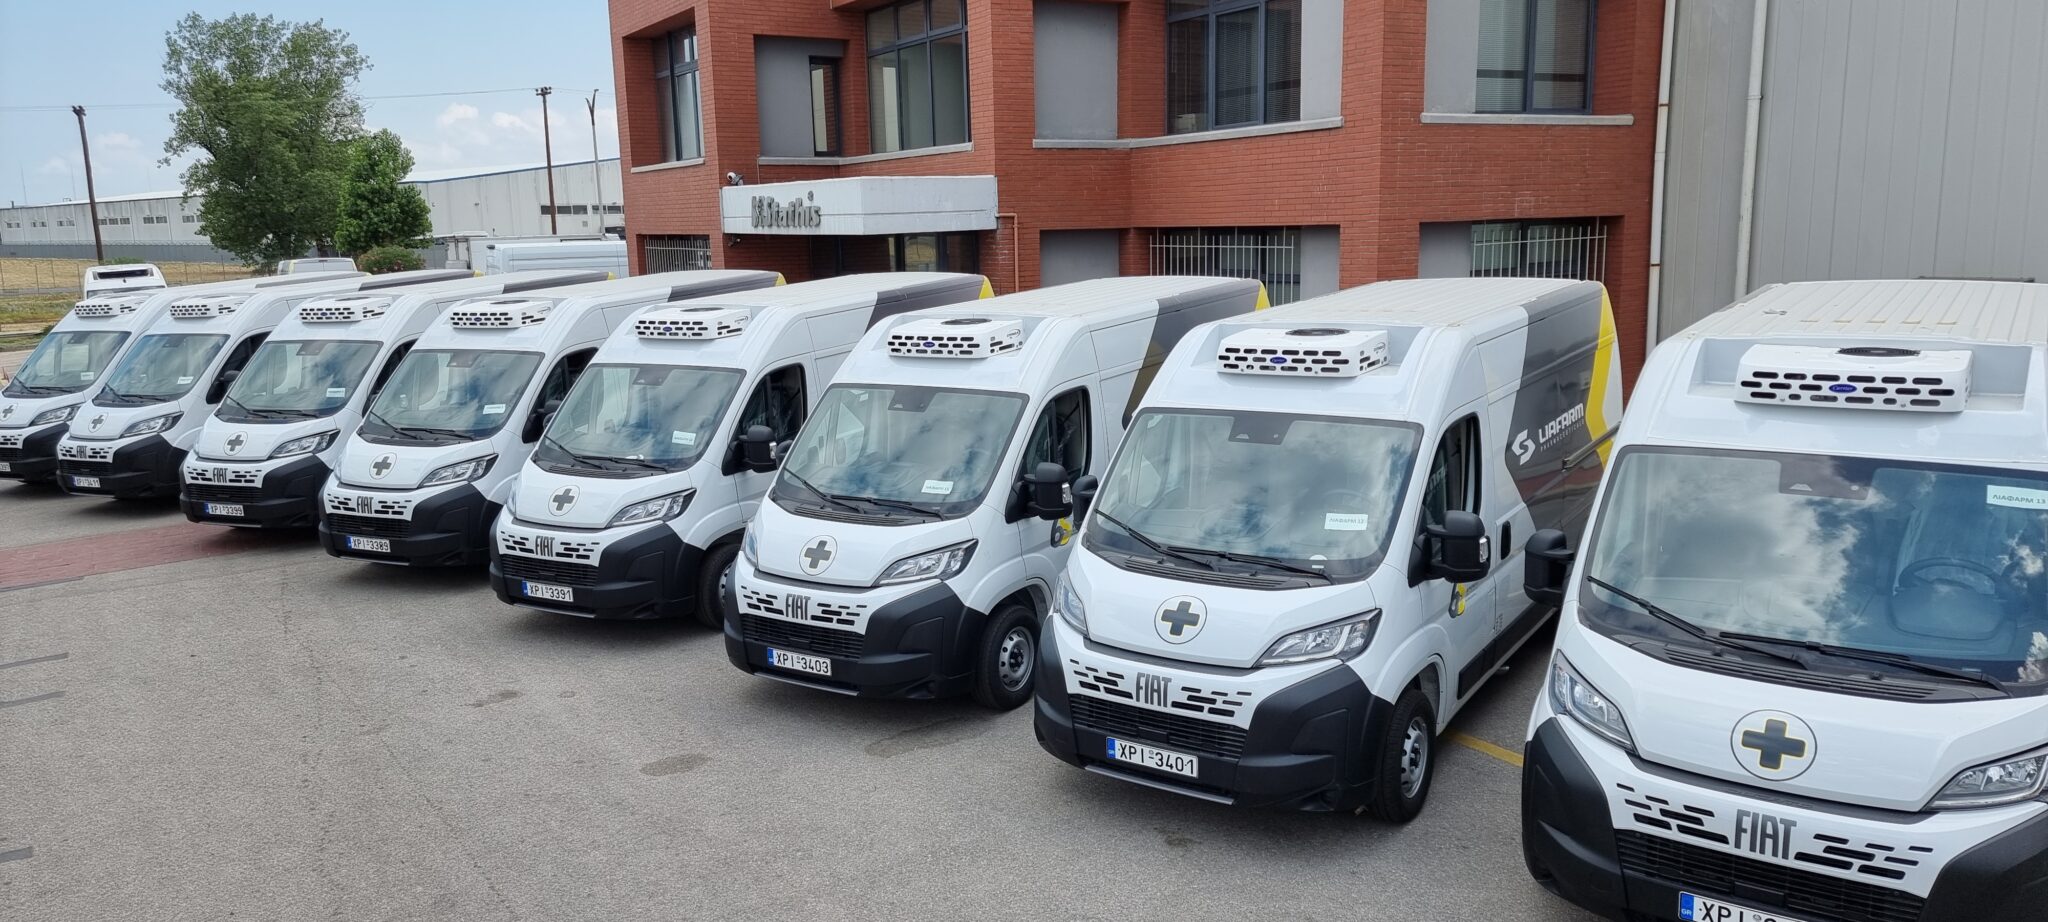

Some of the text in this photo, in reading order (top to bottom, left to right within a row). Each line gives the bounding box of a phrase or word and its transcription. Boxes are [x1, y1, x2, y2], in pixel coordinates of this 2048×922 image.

[1539, 403, 1584, 443] LIAFARM
[213, 467, 228, 483] FIAT
[356, 495, 374, 515] FIAT
[535, 535, 556, 558] FIAT
[785, 593, 812, 621] FIAT
[1135, 671, 1173, 708] FIAT
[1734, 808, 1798, 861] FIAT
